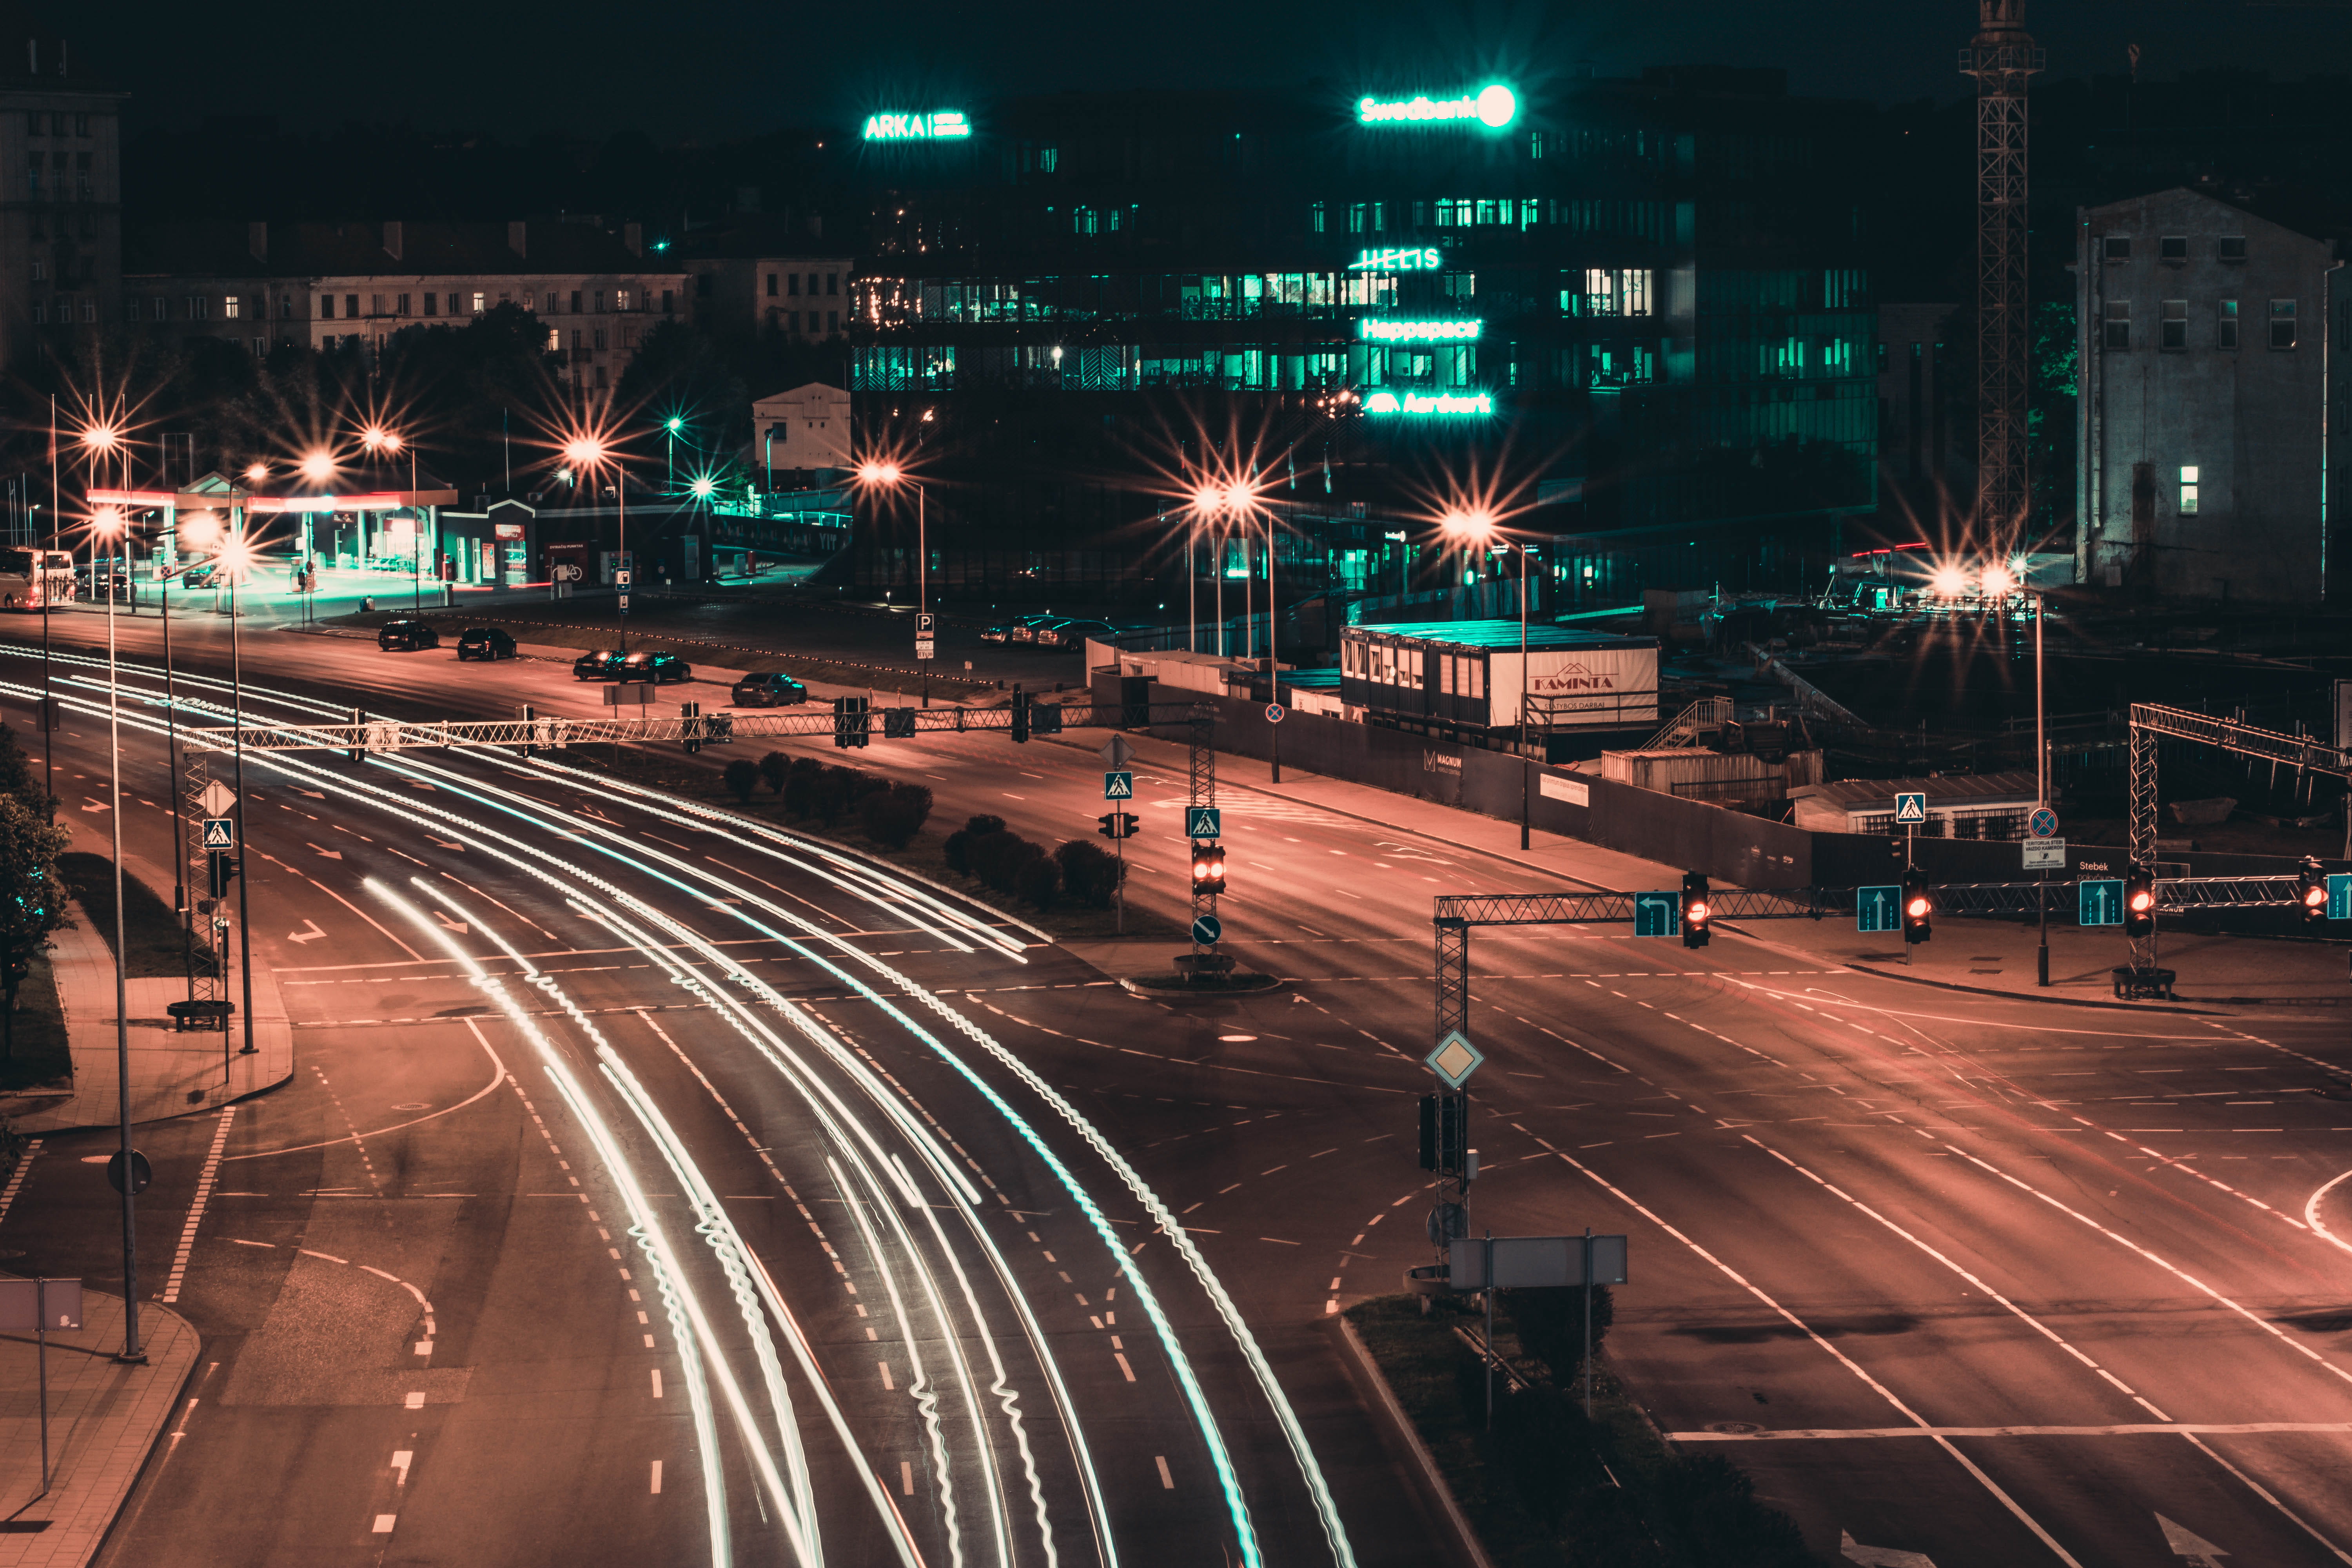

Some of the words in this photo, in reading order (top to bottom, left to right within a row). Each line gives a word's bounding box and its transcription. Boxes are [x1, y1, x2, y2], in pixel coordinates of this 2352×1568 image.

[1361, 96, 1477, 122] Swedbank
[865, 114, 925, 139] ARKA
[921, 616, 931, 630] P
[1535, 677, 1613, 690] KAMINTA
[1437, 753, 1461, 768] MAGNUM
[2080, 861, 2109, 871] Stebėk
